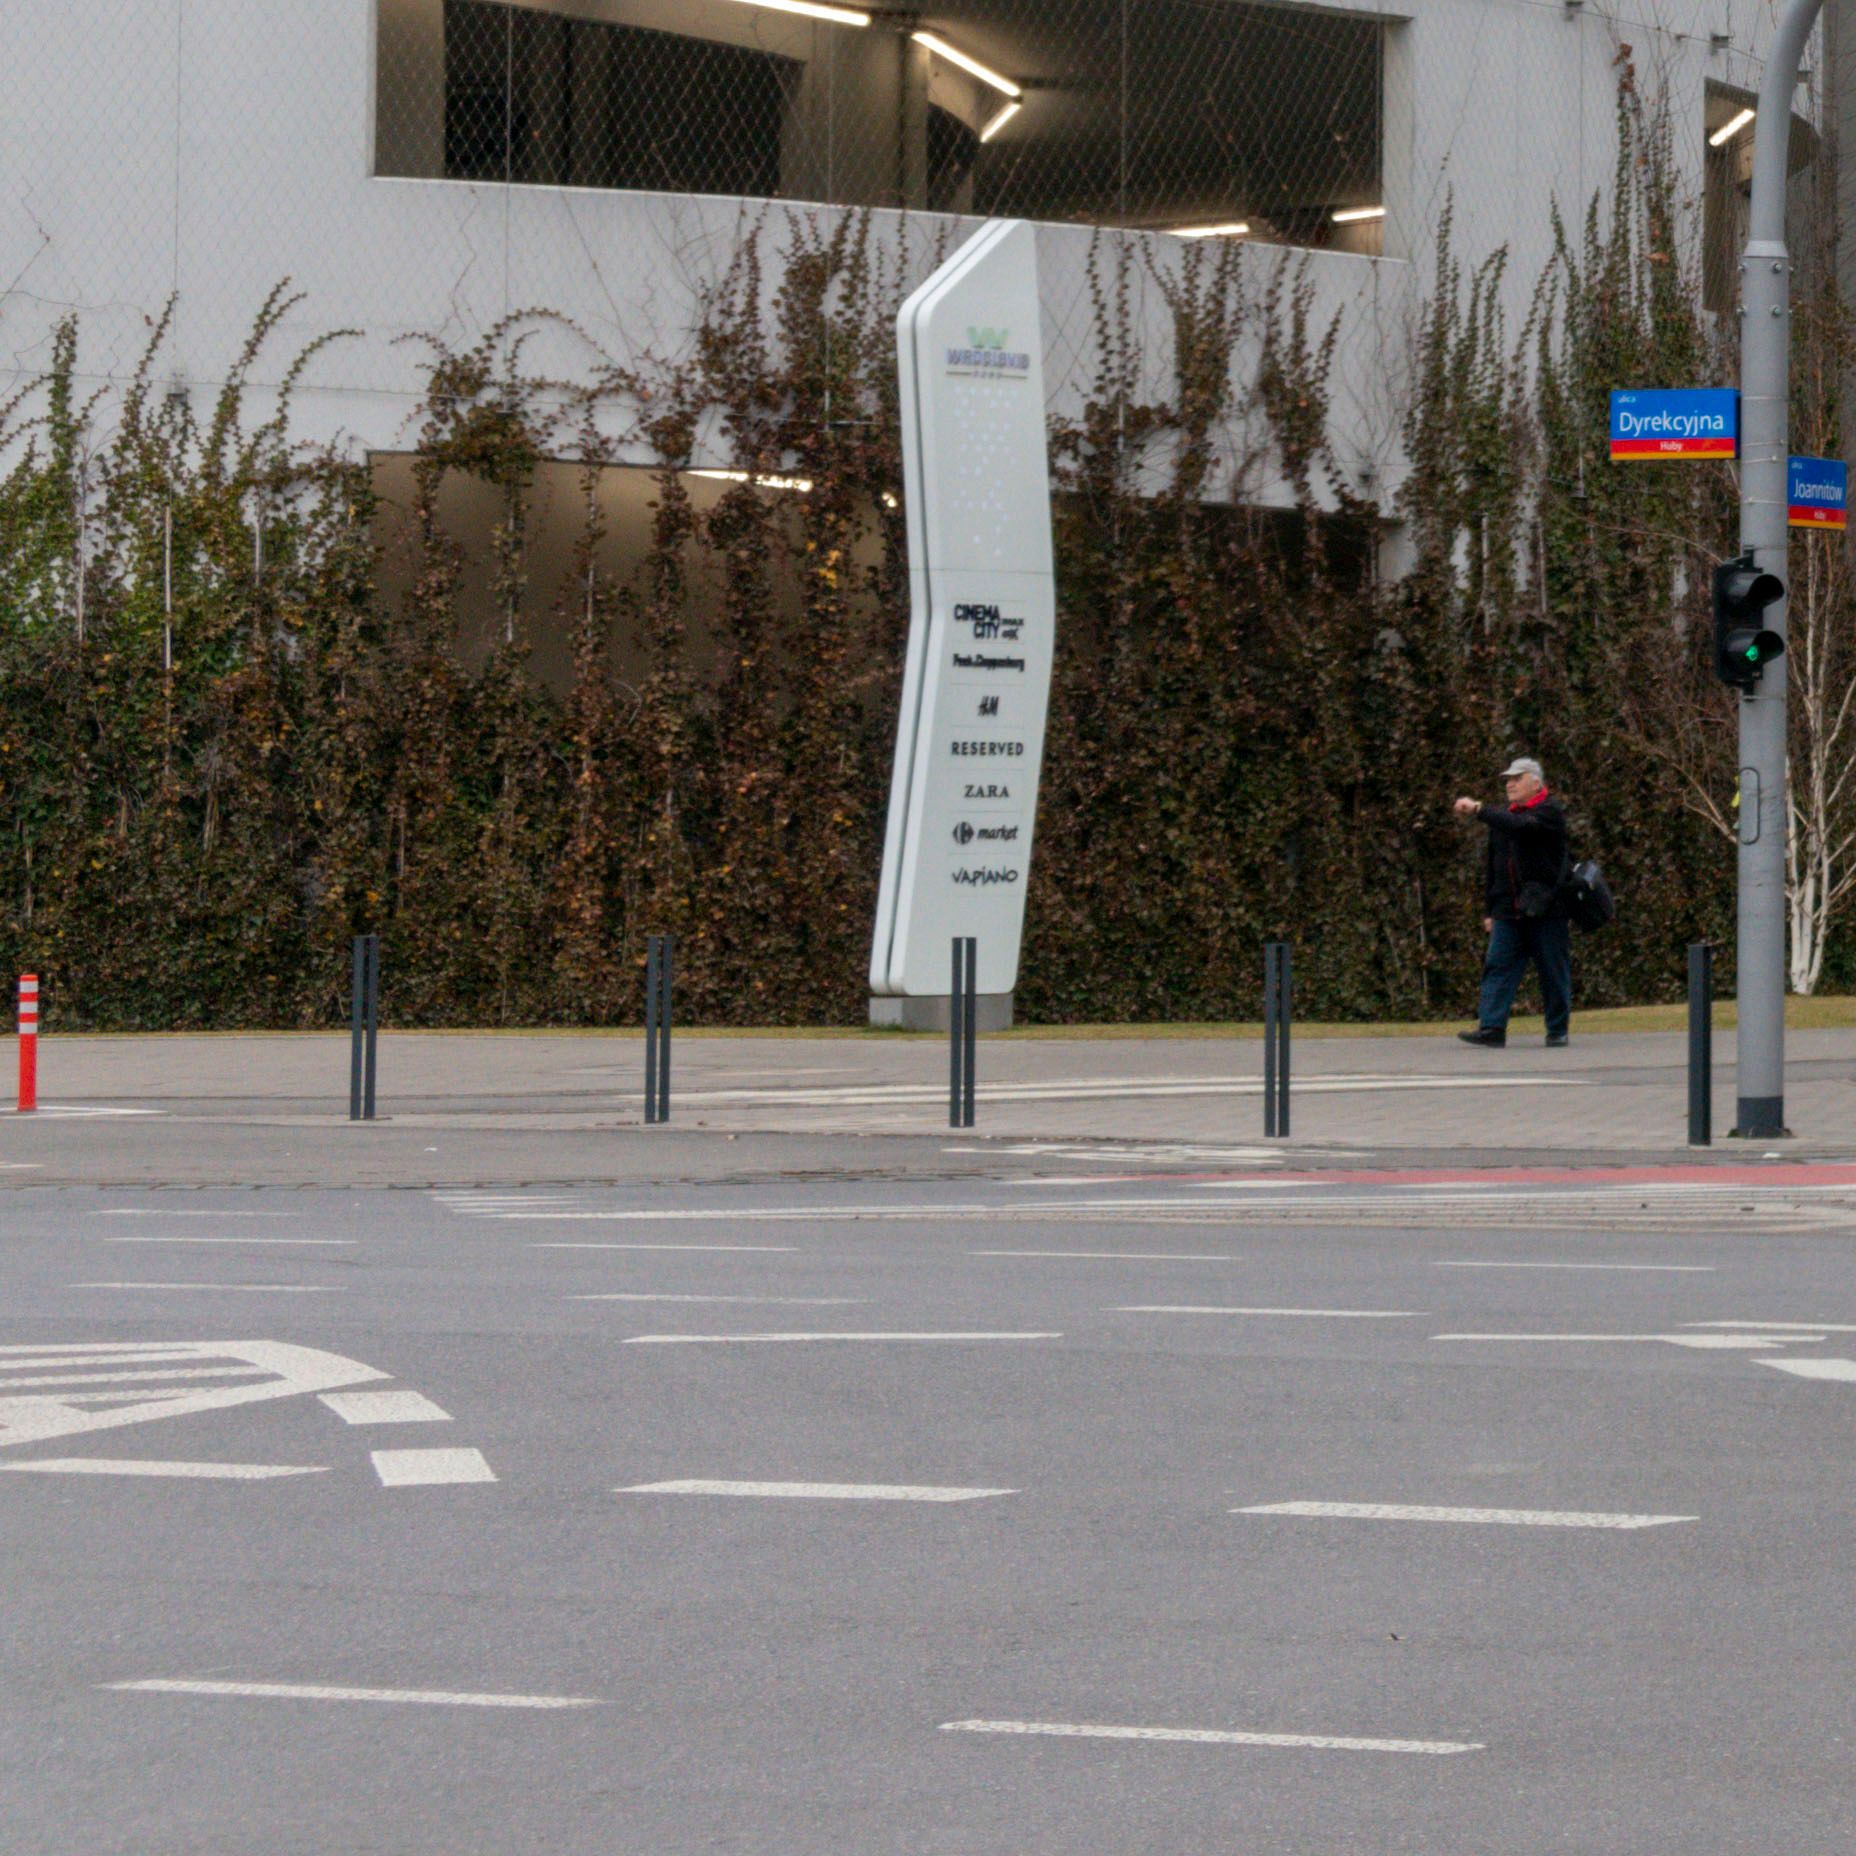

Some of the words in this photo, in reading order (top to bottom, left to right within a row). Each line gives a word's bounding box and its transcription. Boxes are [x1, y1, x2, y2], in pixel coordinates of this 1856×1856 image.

[1619, 410, 1724, 437] Dyrekcyjna
[1794, 477, 1843, 501] Joannitów
[954, 604, 999, 621] CINEMA
[973, 622, 999, 639] CITY
[951, 741, 1024, 756] RESERVED
[964, 785, 1010, 798] ZARA
[976, 825, 1019, 841] market
